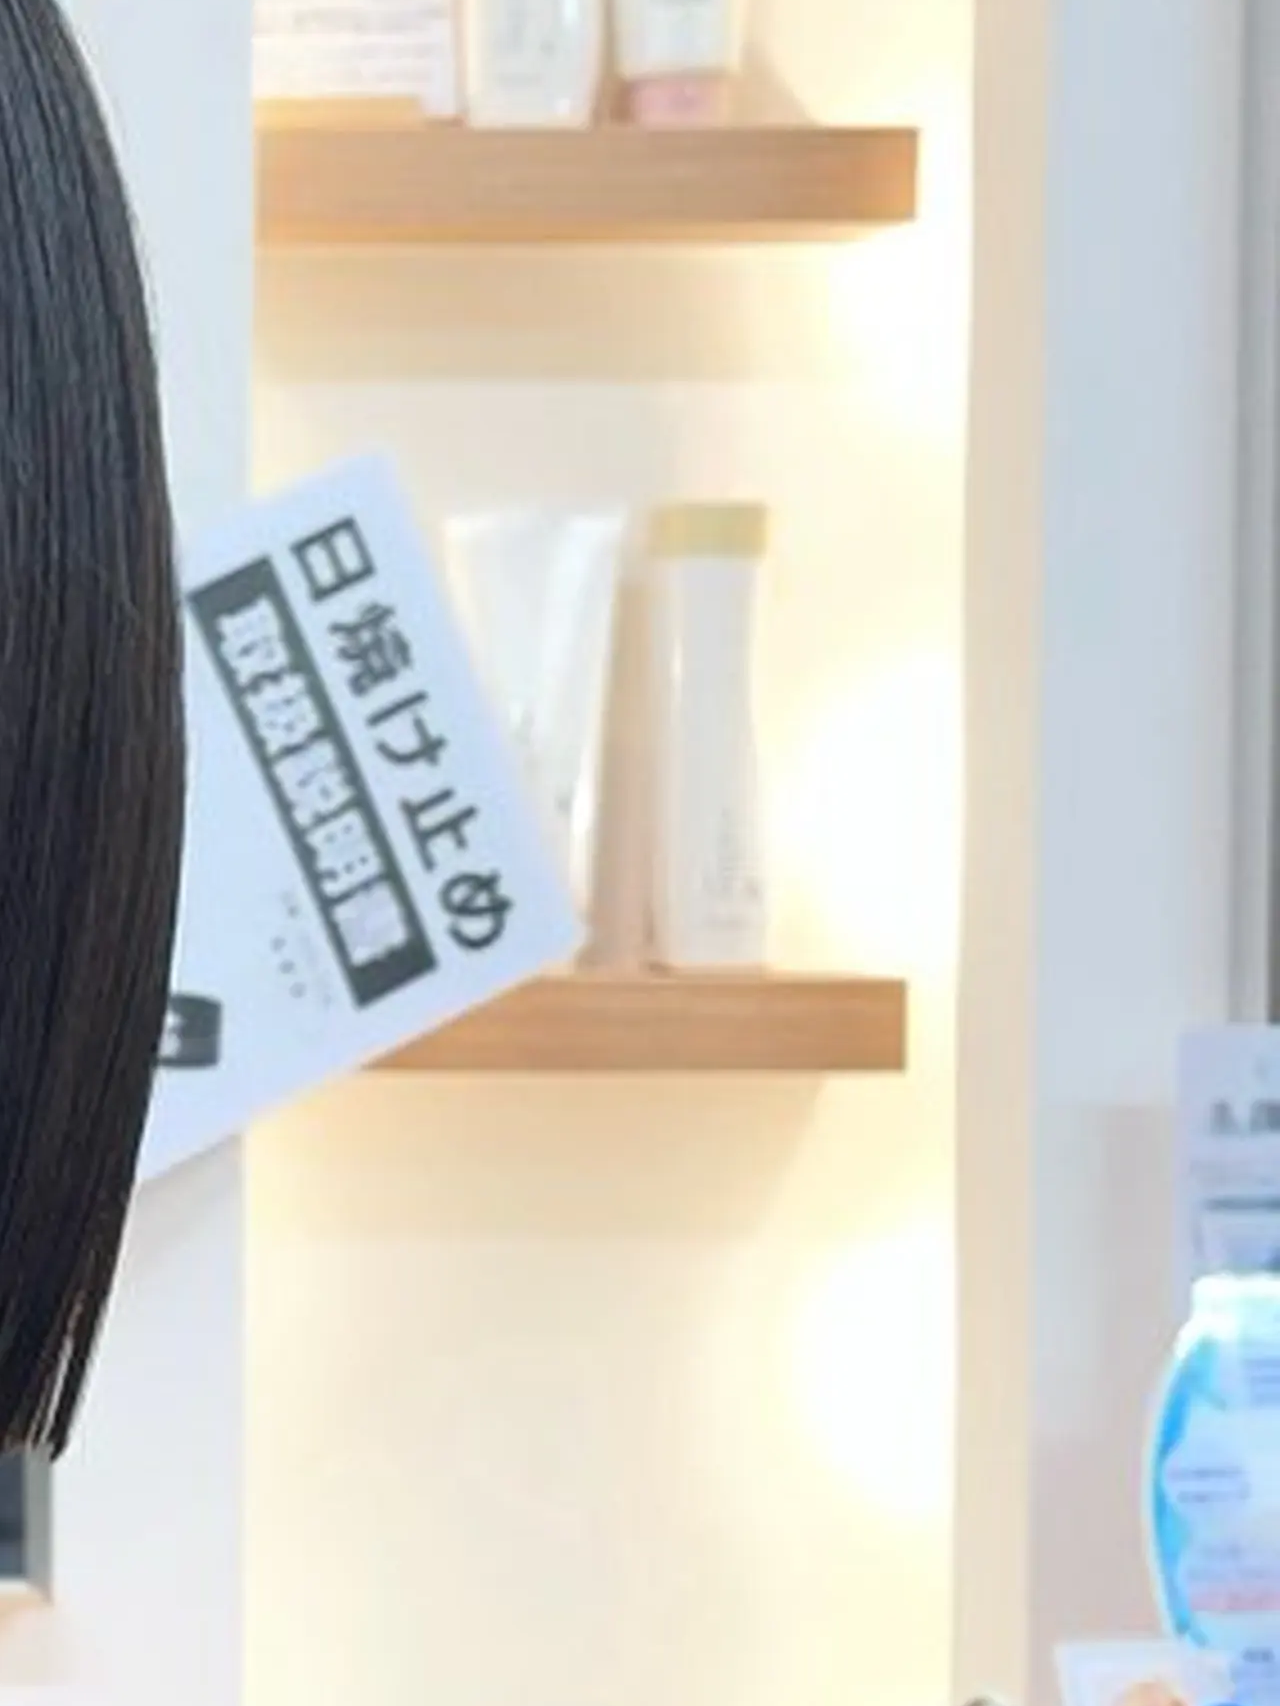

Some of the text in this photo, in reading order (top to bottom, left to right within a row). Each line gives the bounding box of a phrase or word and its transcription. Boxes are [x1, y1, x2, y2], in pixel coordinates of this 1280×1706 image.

[289, 515, 514, 952] 日焼け止め
